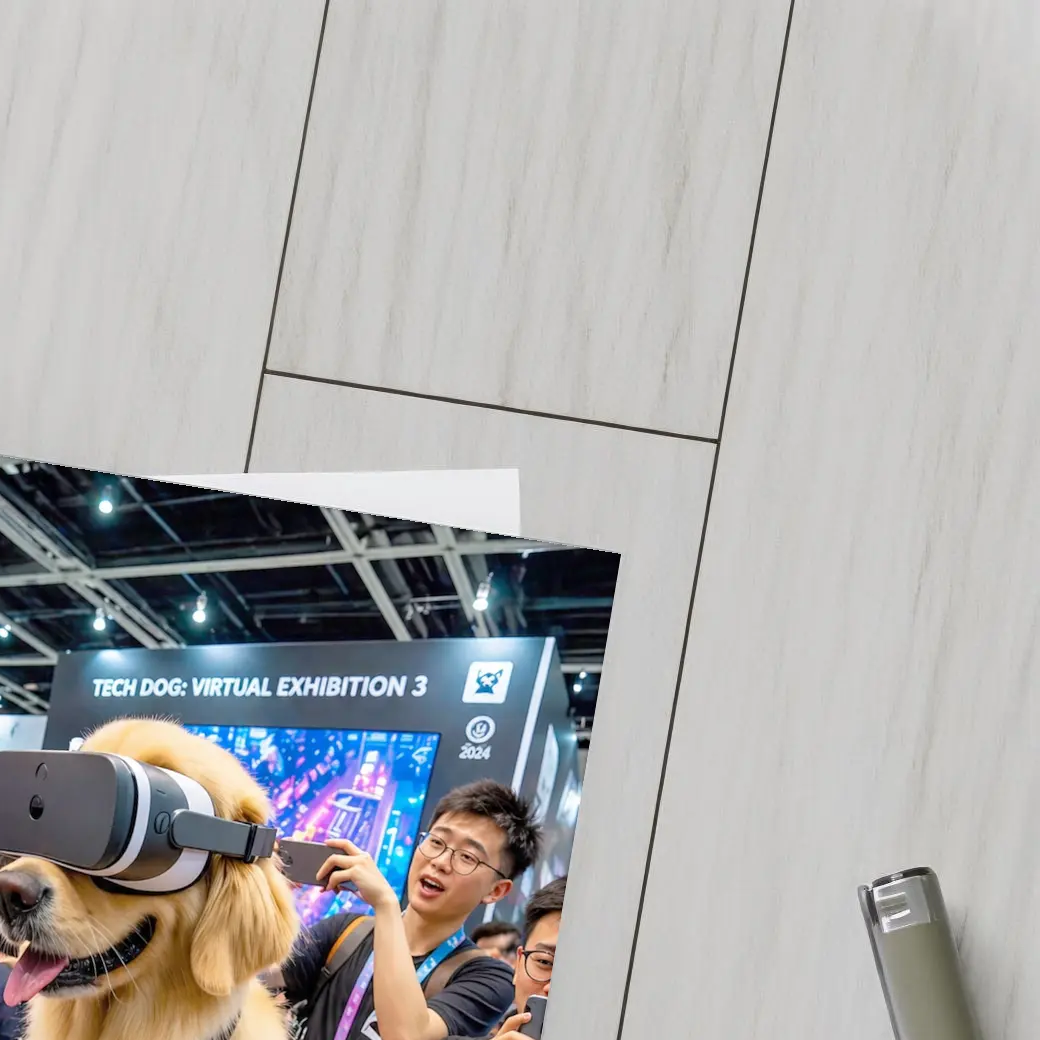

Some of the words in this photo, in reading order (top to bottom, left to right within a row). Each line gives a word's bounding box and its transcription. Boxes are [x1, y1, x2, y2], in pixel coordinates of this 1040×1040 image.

[93, 677, 138, 698] TECH
[139, 677, 188, 698] DOG:
[191, 676, 273, 698] VIRTUAL
[276, 675, 408, 698] EXHIBITION
[411, 675, 429, 698] 3
[459, 744, 491, 760] 2024
